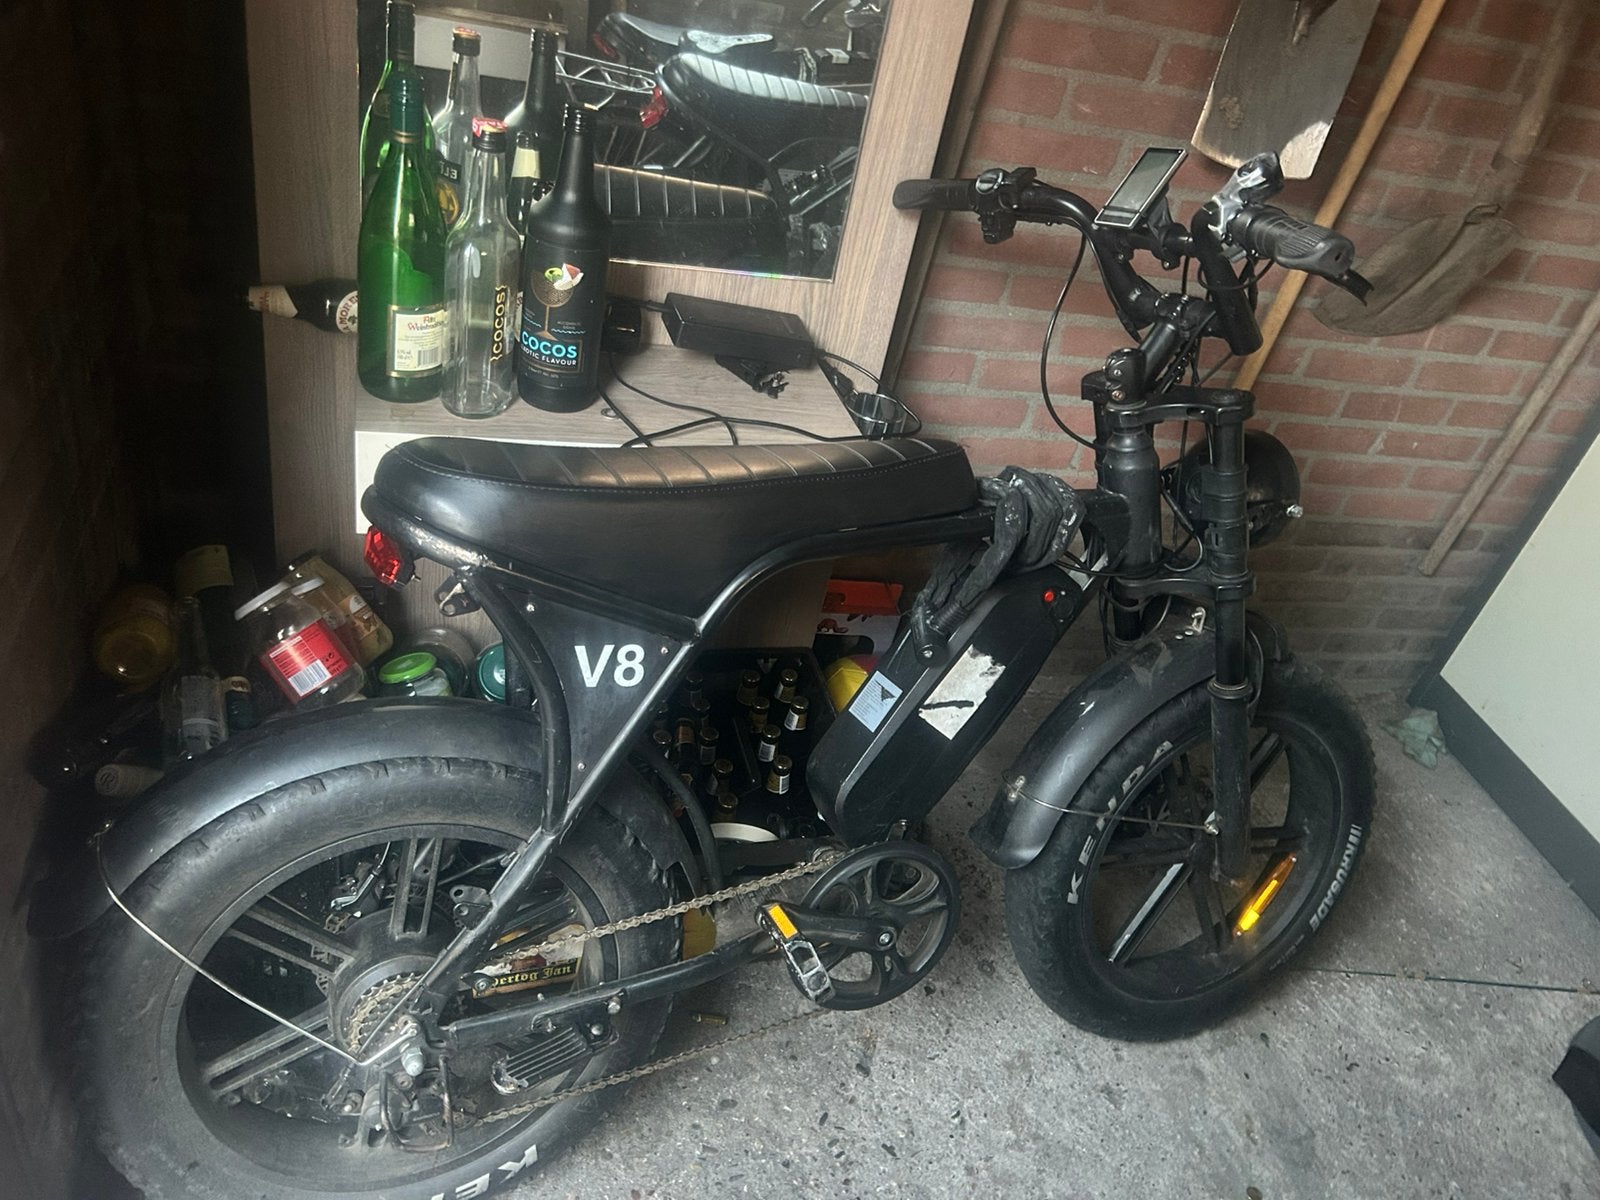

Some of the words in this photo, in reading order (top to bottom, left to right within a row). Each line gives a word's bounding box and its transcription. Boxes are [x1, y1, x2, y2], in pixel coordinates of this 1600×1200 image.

[493, 291, 506, 354] COCOS
[521, 330, 578, 359] COCOS
[541, 355, 577, 366] FLAVOUR
[574, 643, 645, 687] V8
[430, 1143, 539, 1200] KE
